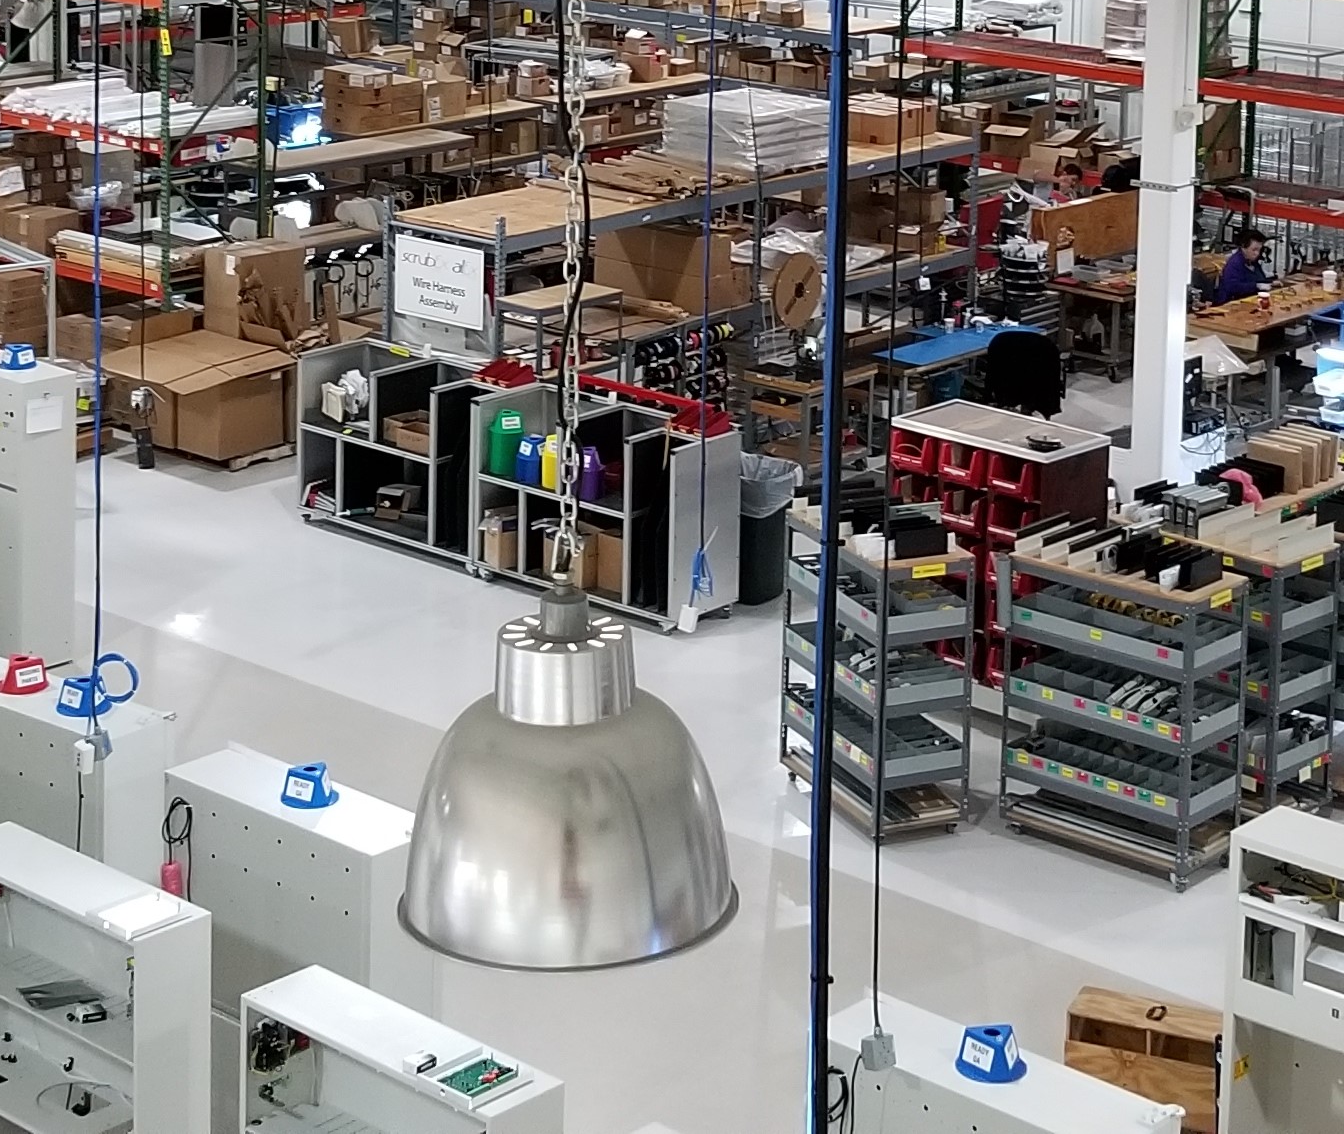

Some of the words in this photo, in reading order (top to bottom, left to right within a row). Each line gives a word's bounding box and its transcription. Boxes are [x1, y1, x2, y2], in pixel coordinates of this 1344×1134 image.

[412, 276, 431, 290] Wire
[432, 280, 465, 297] Harness
[419, 295, 459, 314] Assembly
[971, 1042, 990, 1056] READY
